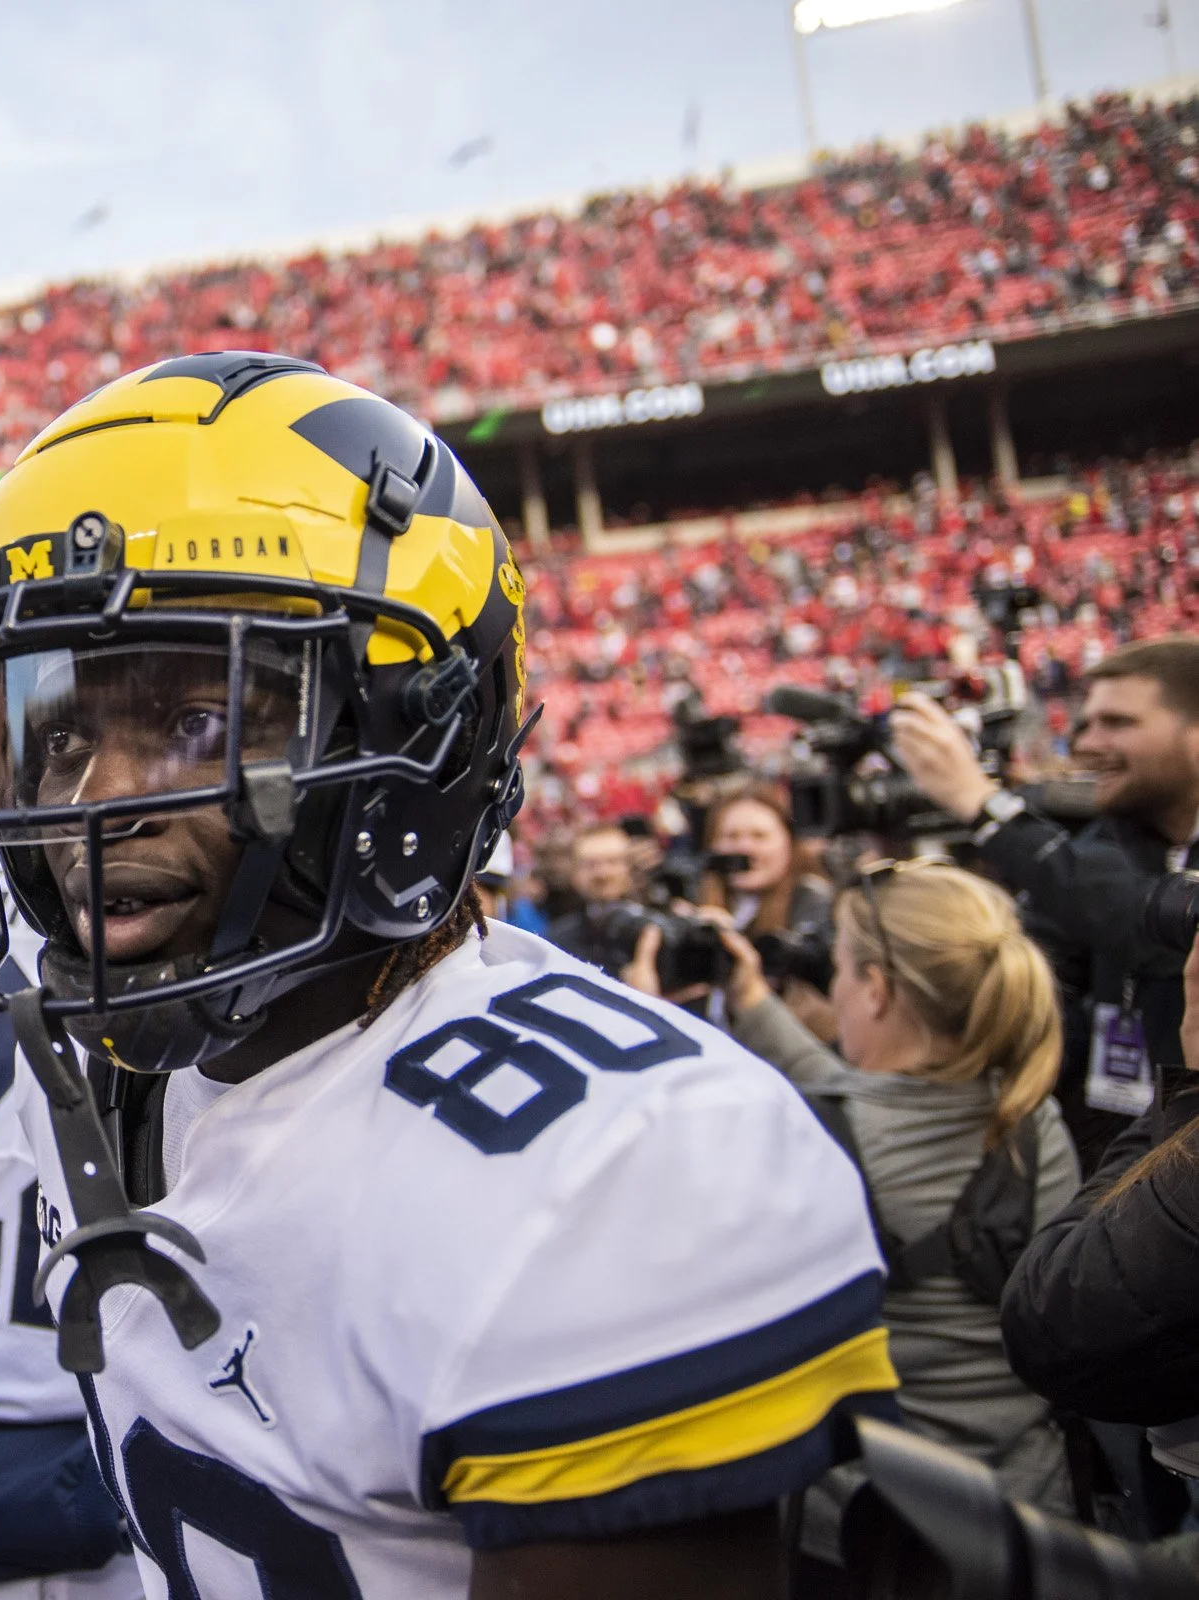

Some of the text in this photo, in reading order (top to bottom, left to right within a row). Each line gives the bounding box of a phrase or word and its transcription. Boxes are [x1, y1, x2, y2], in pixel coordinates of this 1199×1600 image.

[6, 539, 55, 584] M
[166, 535, 290, 564] JORDAN
[384, 972, 704, 1156] 80
